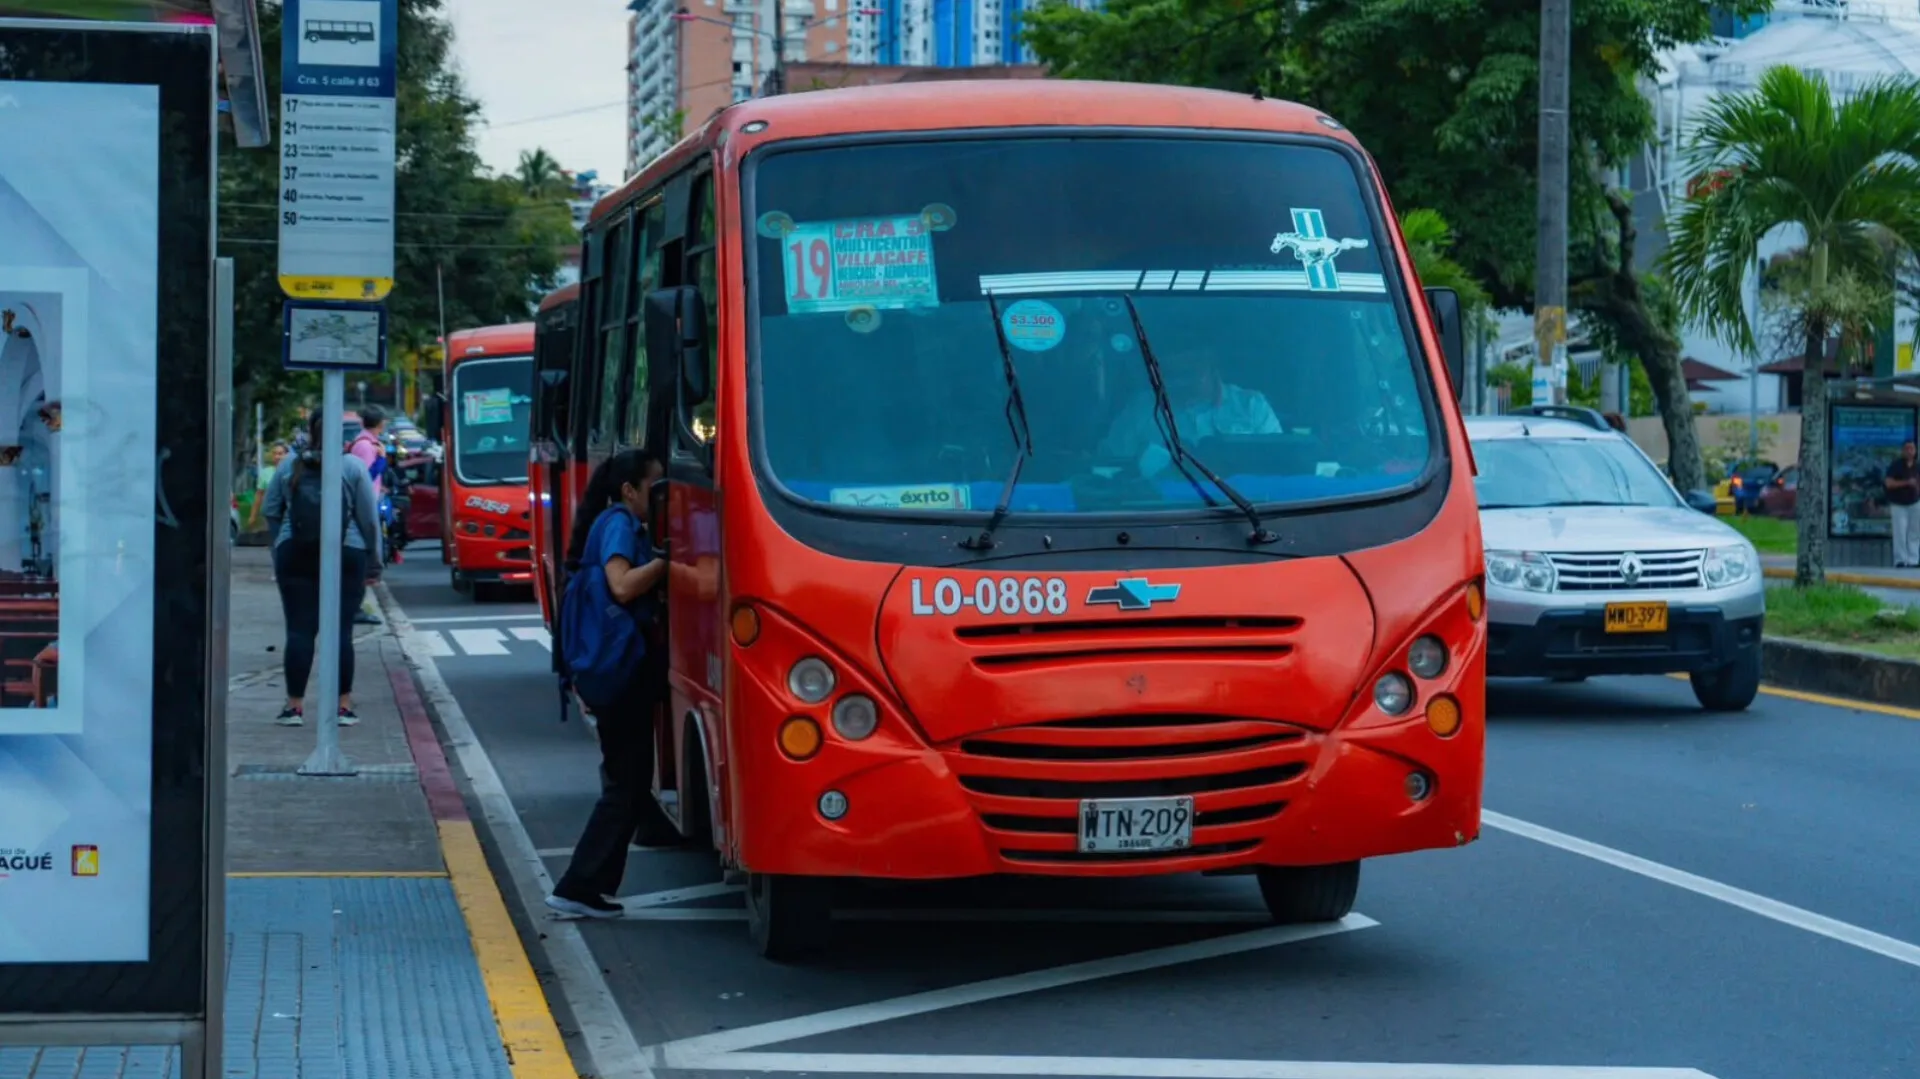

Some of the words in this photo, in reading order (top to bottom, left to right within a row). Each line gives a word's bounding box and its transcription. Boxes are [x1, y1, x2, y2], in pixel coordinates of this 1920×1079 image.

[322, 75, 329, 86] 5
[331, 75, 356, 86] calle
[367, 76, 380, 88] 63
[285, 98, 298, 113] 17
[284, 120, 297, 135] 21
[284, 143, 297, 158] 23
[284, 165, 298, 180] 37
[283, 188, 297, 202] 40
[283, 211, 297, 225] 50
[835, 219, 896, 239] CRA
[835, 235, 929, 253] MULTICENTRO
[790, 238, 831, 299] 19
[900, 489, 950, 505] éxito
[911, 577, 1068, 615] LO-0868
